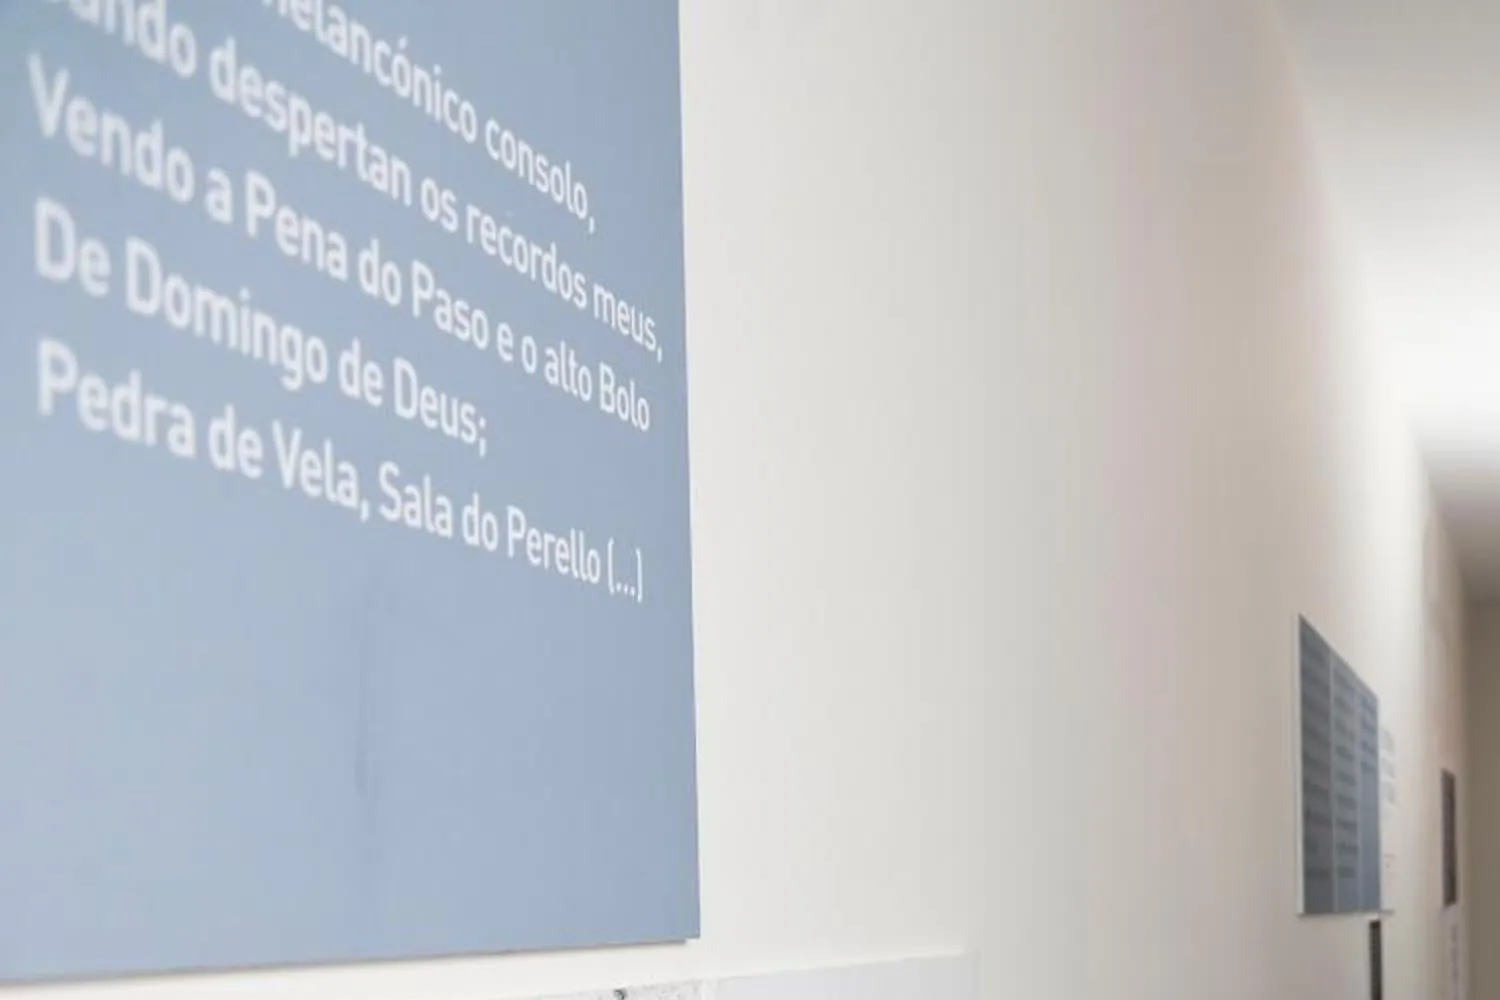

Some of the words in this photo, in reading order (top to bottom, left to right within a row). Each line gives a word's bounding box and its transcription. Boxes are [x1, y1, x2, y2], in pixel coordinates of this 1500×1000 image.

[28, 51, 194, 203] Vendo
[204, 166, 232, 224] a
[245, 171, 347, 281] Pena
[359, 238, 401, 306] do
[412, 260, 489, 350] Paso
[497, 322, 514, 361] e
[521, 335, 537, 374] o
[544, 342, 592, 402] alto
[600, 362, 650, 432] Bolo
[66, 0, 197, 78] ando
[208, 35, 412, 207] despertan
[420, 180, 458, 233] os
[466, 203, 587, 310] recordos
[593, 283, 663, 362] meus,
[261, 0, 477, 143] elancónico
[485, 116, 595, 233] consolo,
[35, 197, 110, 297] De
[126, 236, 327, 391] Domingo
[339, 340, 383, 405] de
[394, 359, 486, 457] Deus;
[38, 339, 196, 458] Pedra
[208, 405, 263, 479] de
[273, 420, 369, 523] Vela,
[379, 462, 453, 538] Sala
[462, 493, 499, 553] do
[507, 505, 600, 584] Perello
[608, 538, 642, 603] (...)
